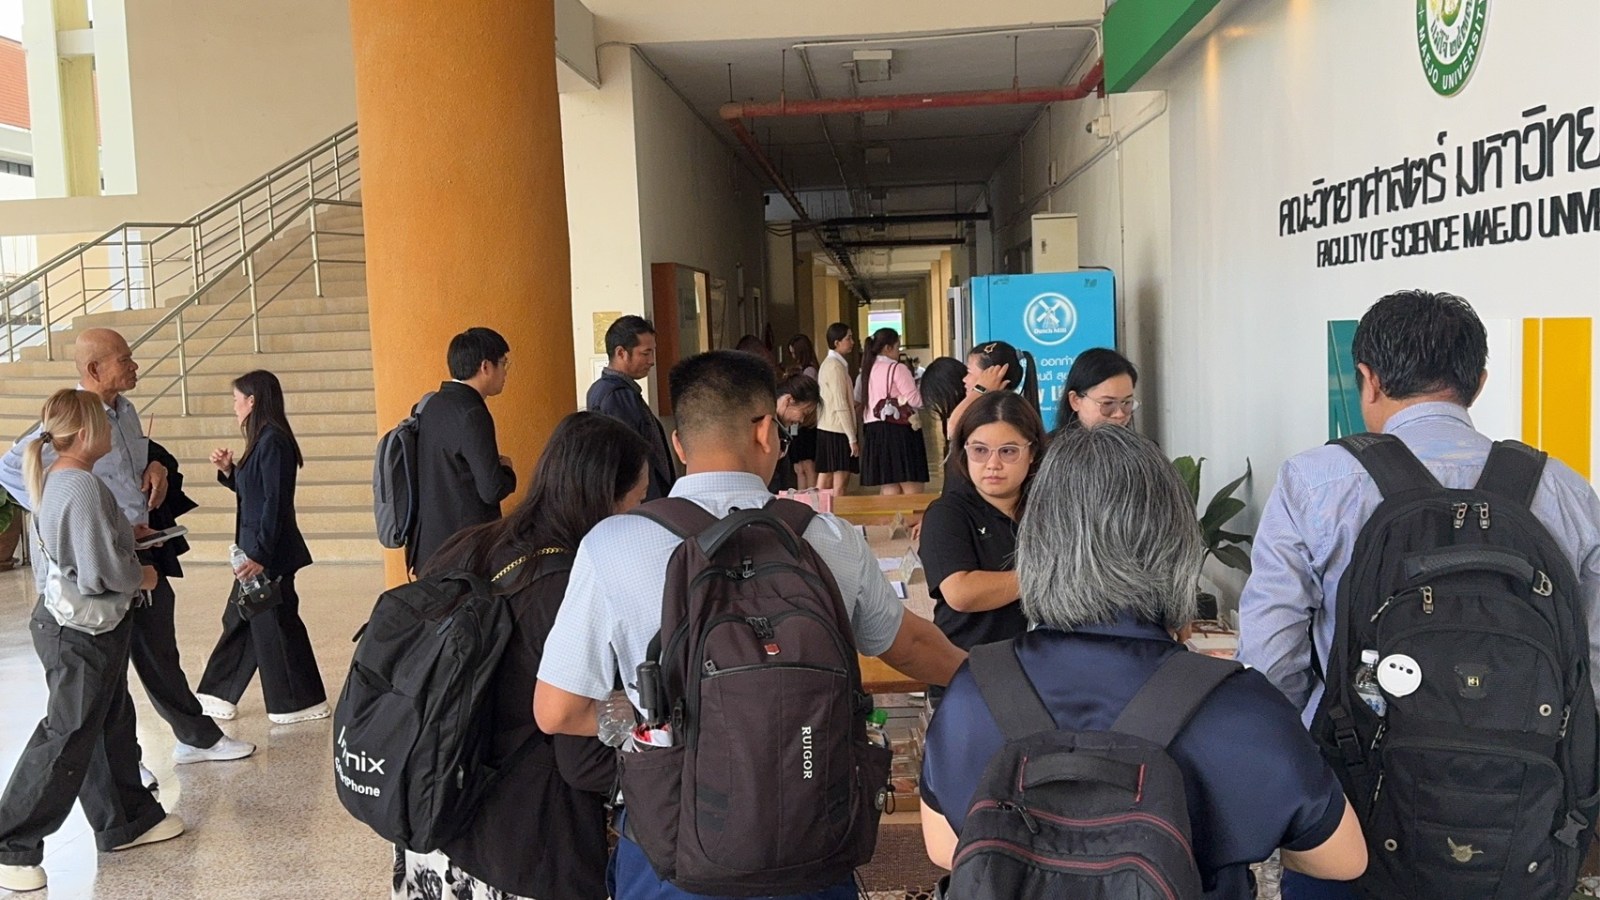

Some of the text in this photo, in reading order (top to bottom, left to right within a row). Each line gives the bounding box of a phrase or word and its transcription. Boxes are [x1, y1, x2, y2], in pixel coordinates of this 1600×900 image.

[1418, 25, 1439, 84] MAEJO
[1279, 131, 1448, 237] คณะวิทยาศาสตร์
[1317, 233, 1368, 268] FACULTY
[1370, 228, 1389, 261] OF
[1391, 215, 1460, 258] SCIENCE
[1463, 202, 1532, 249] MAEJO
[801, 725, 813, 780] RUIGOR
